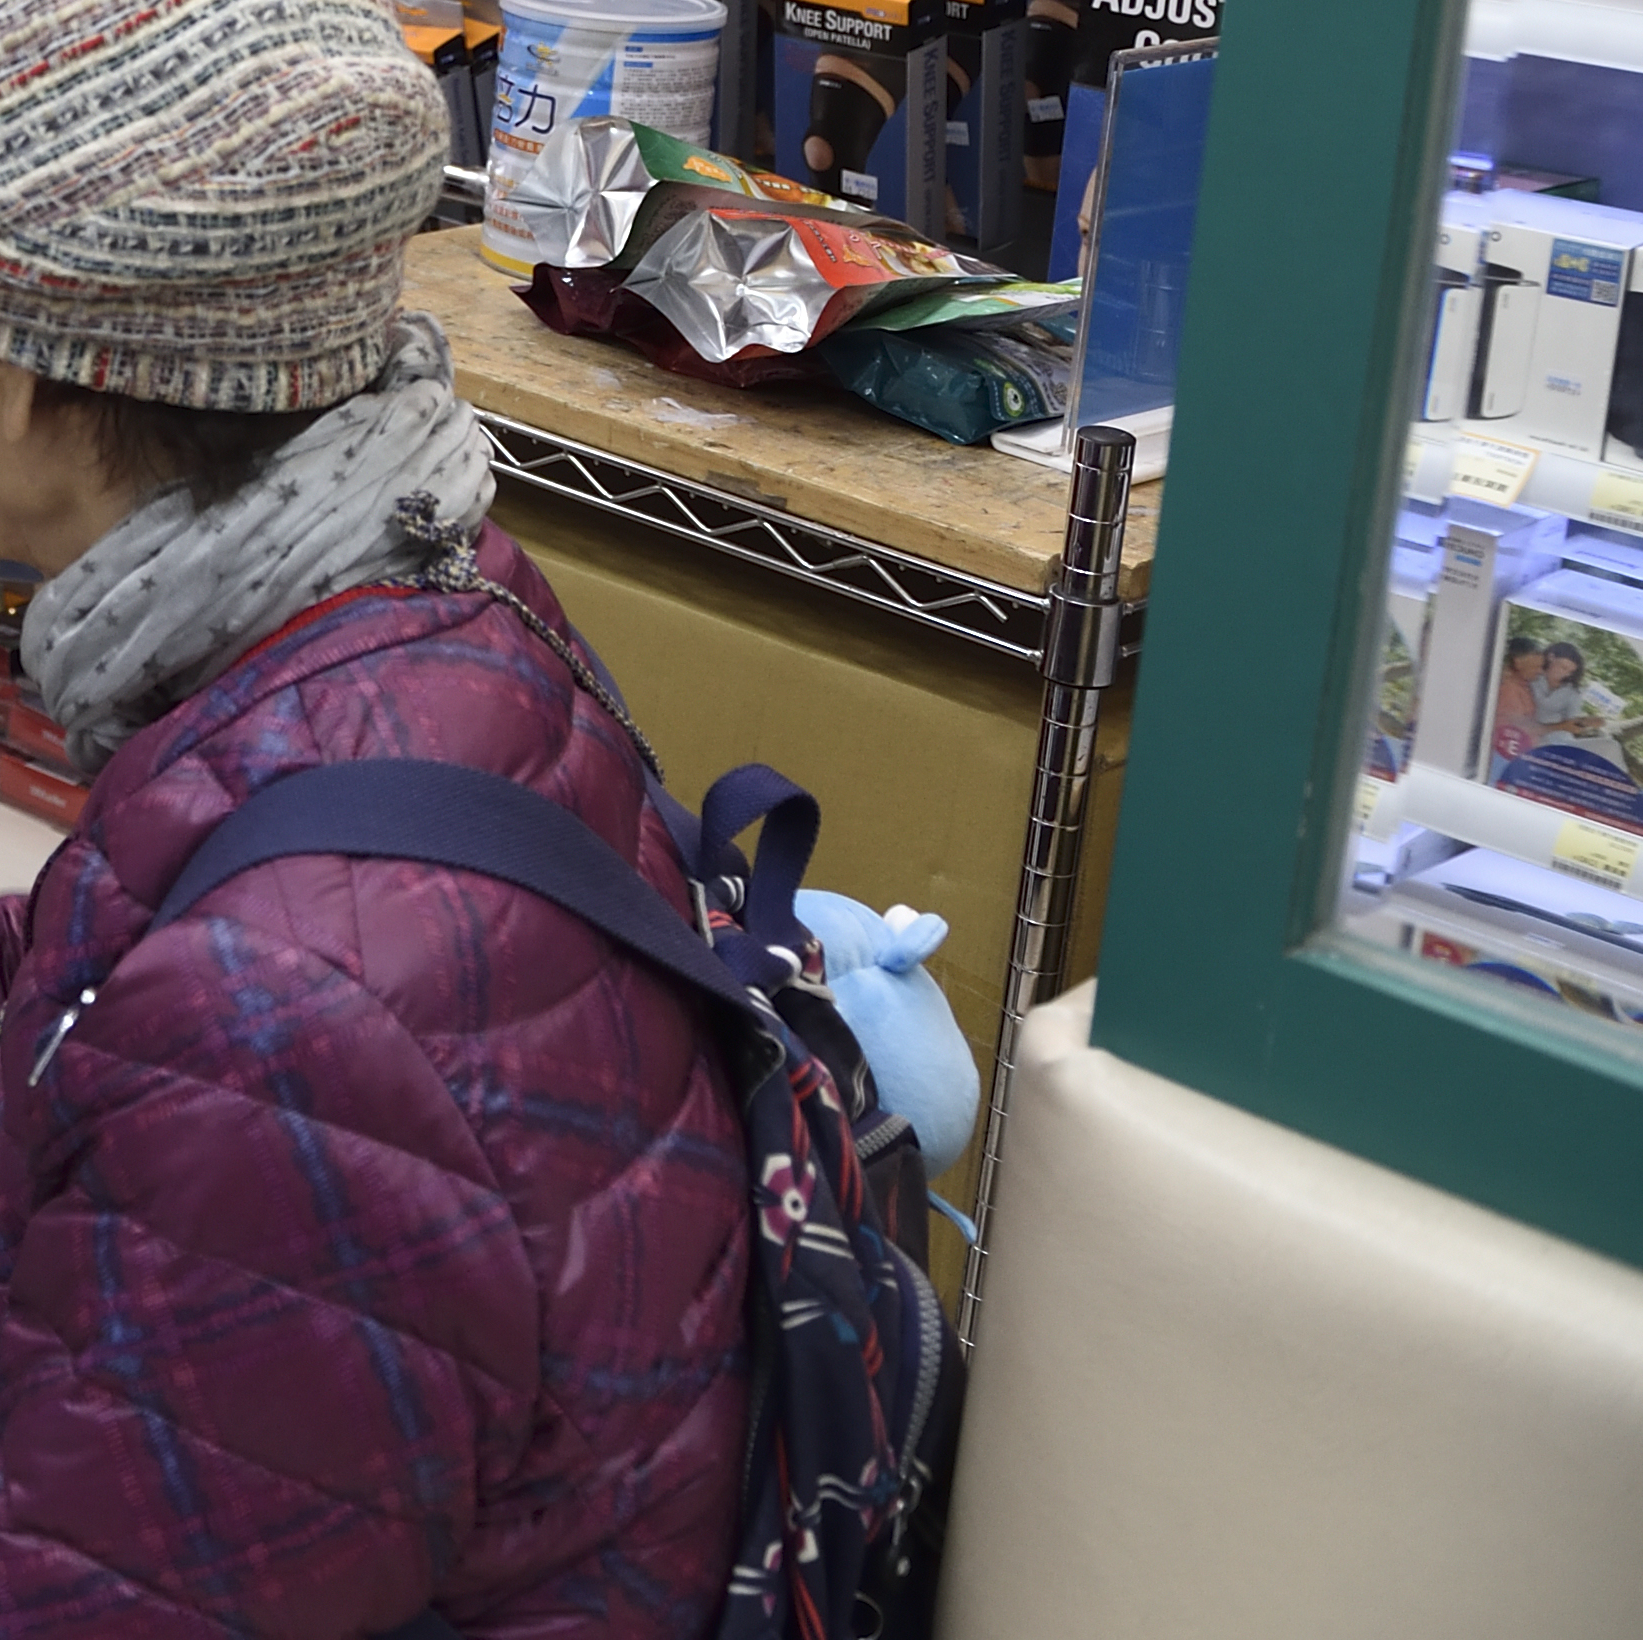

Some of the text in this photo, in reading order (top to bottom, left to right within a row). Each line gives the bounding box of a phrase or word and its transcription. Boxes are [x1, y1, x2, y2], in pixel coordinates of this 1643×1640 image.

[784, 1, 893, 42] KNEE SUPPORT
[922, 47, 940, 91] KNEE
